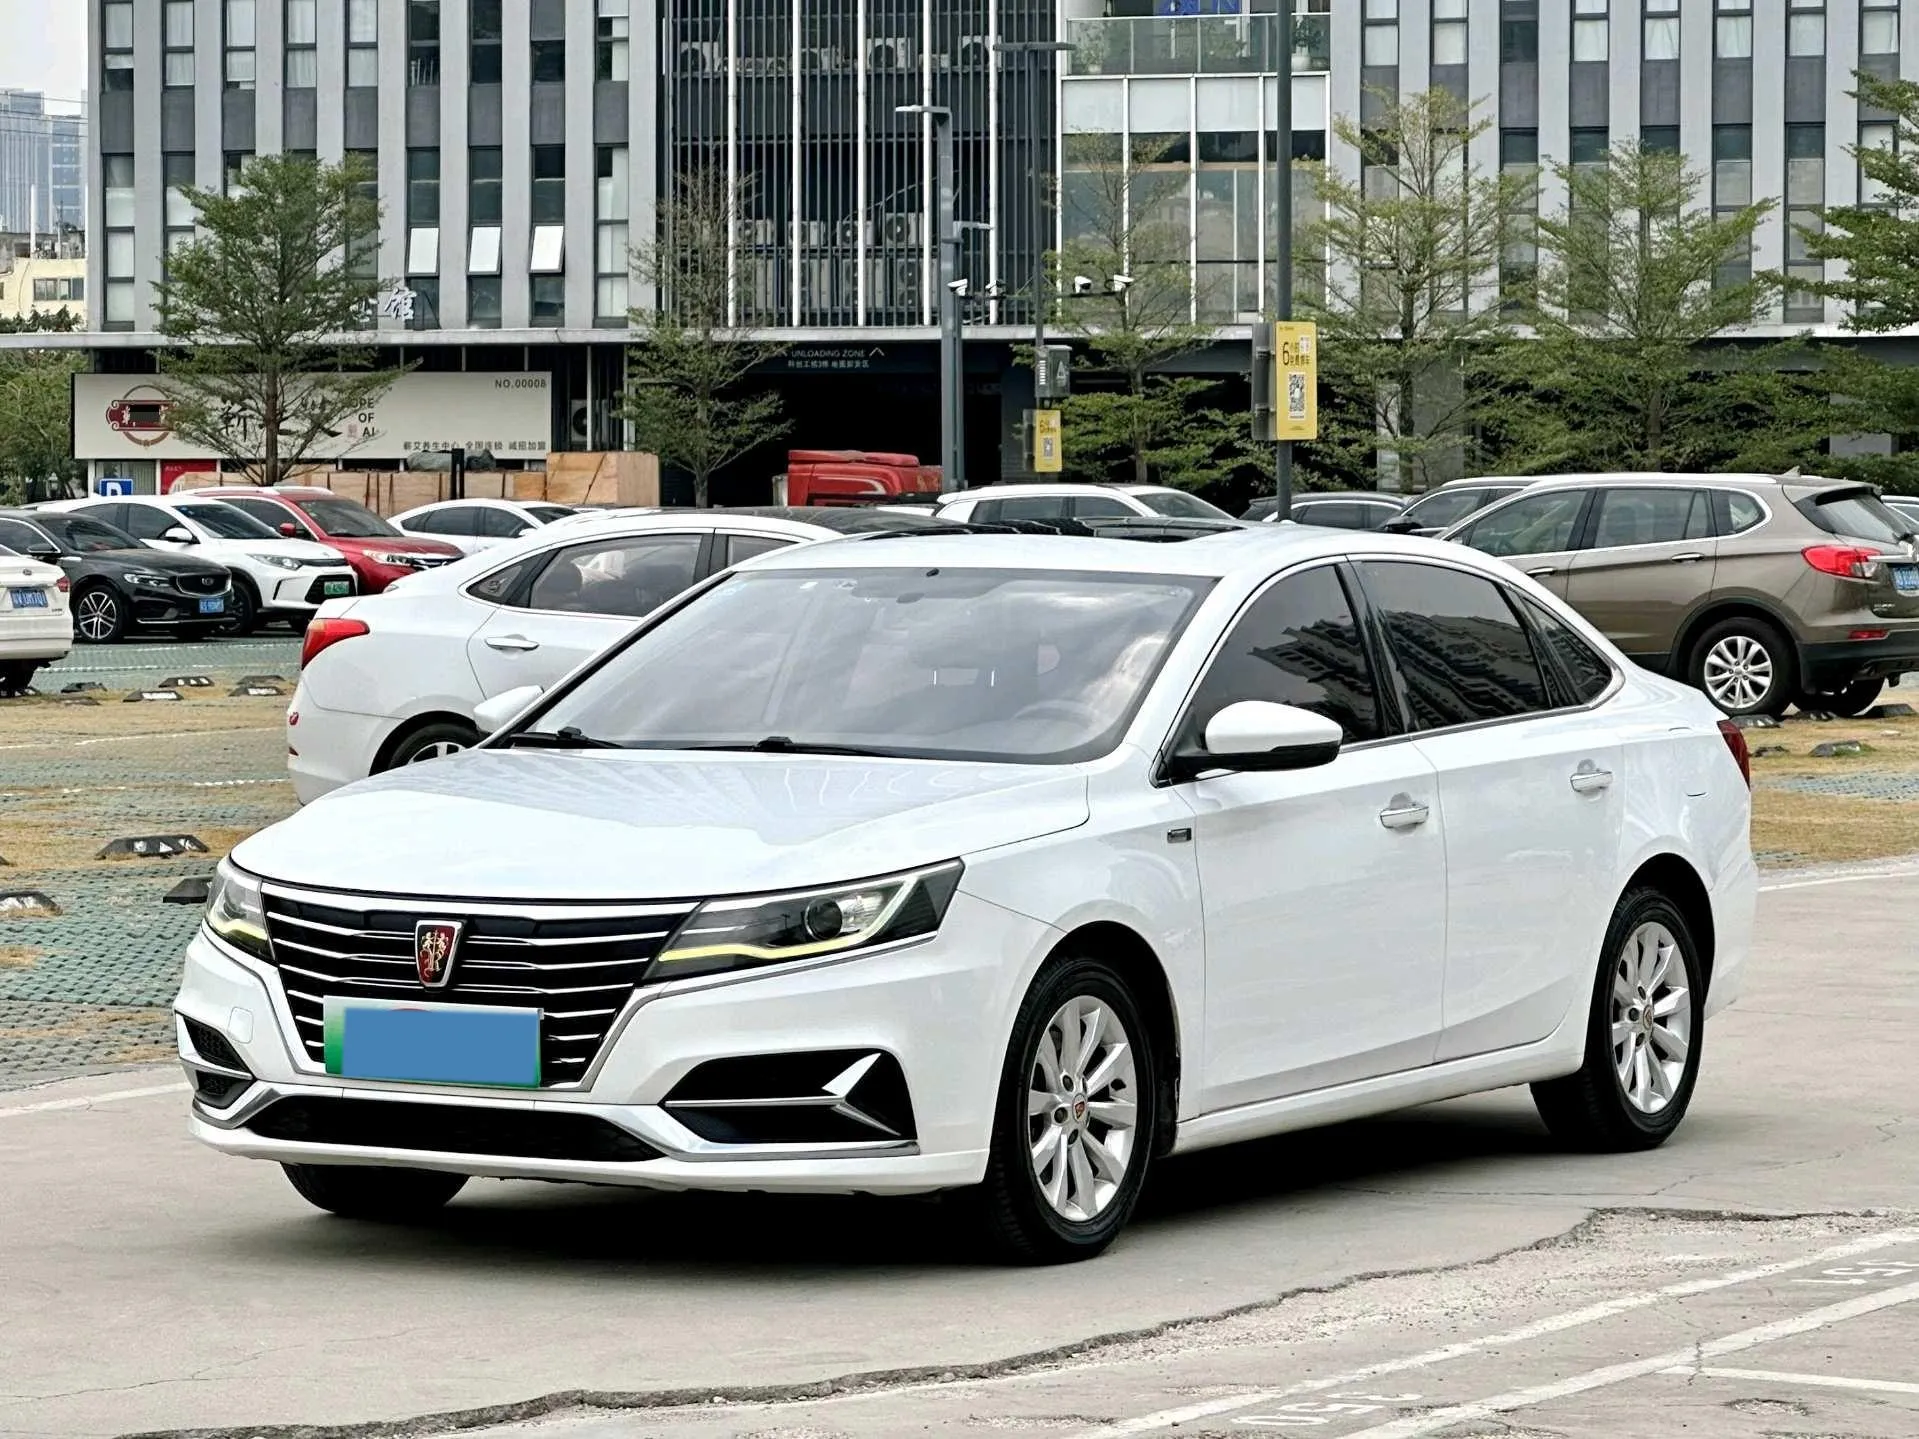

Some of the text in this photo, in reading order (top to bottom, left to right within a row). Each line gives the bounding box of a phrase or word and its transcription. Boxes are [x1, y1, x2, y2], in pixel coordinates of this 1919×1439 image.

[1282, 341, 1290, 365] 6
[495, 379, 546, 388] NO.00008
[358, 412, 375, 423] OF
[362, 426, 375, 437] AI
